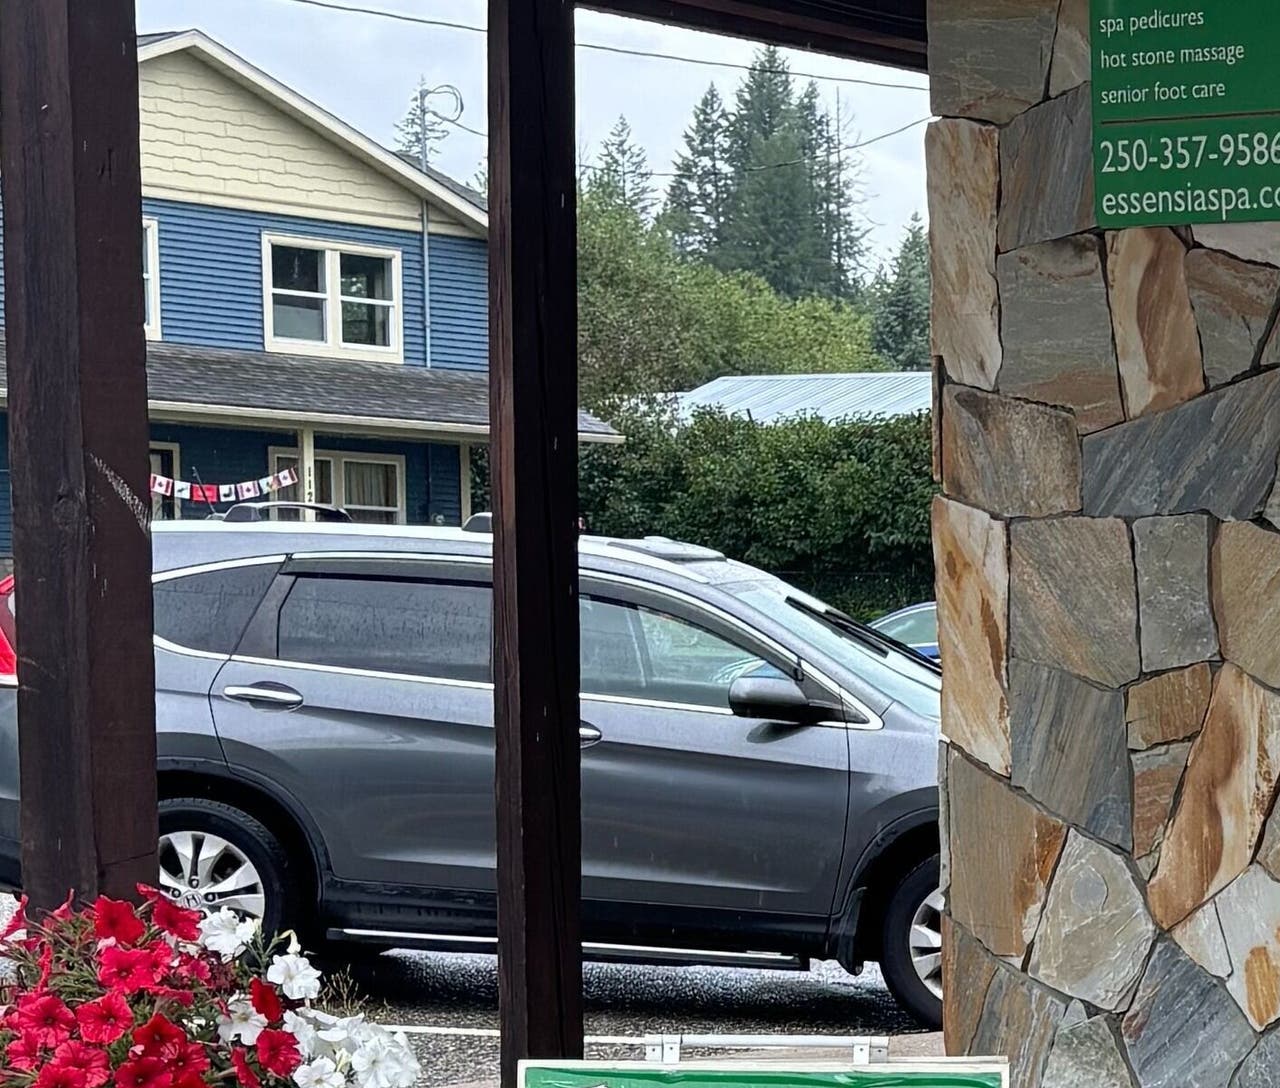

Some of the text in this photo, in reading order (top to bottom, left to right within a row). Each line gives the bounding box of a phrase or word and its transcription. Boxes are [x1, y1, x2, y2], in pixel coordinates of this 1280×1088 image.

[1100, 9, 1204, 38] spa pedicures
[1101, 44, 1245, 68] hot stone massage
[1101, 81, 1226, 104] senior foot care
